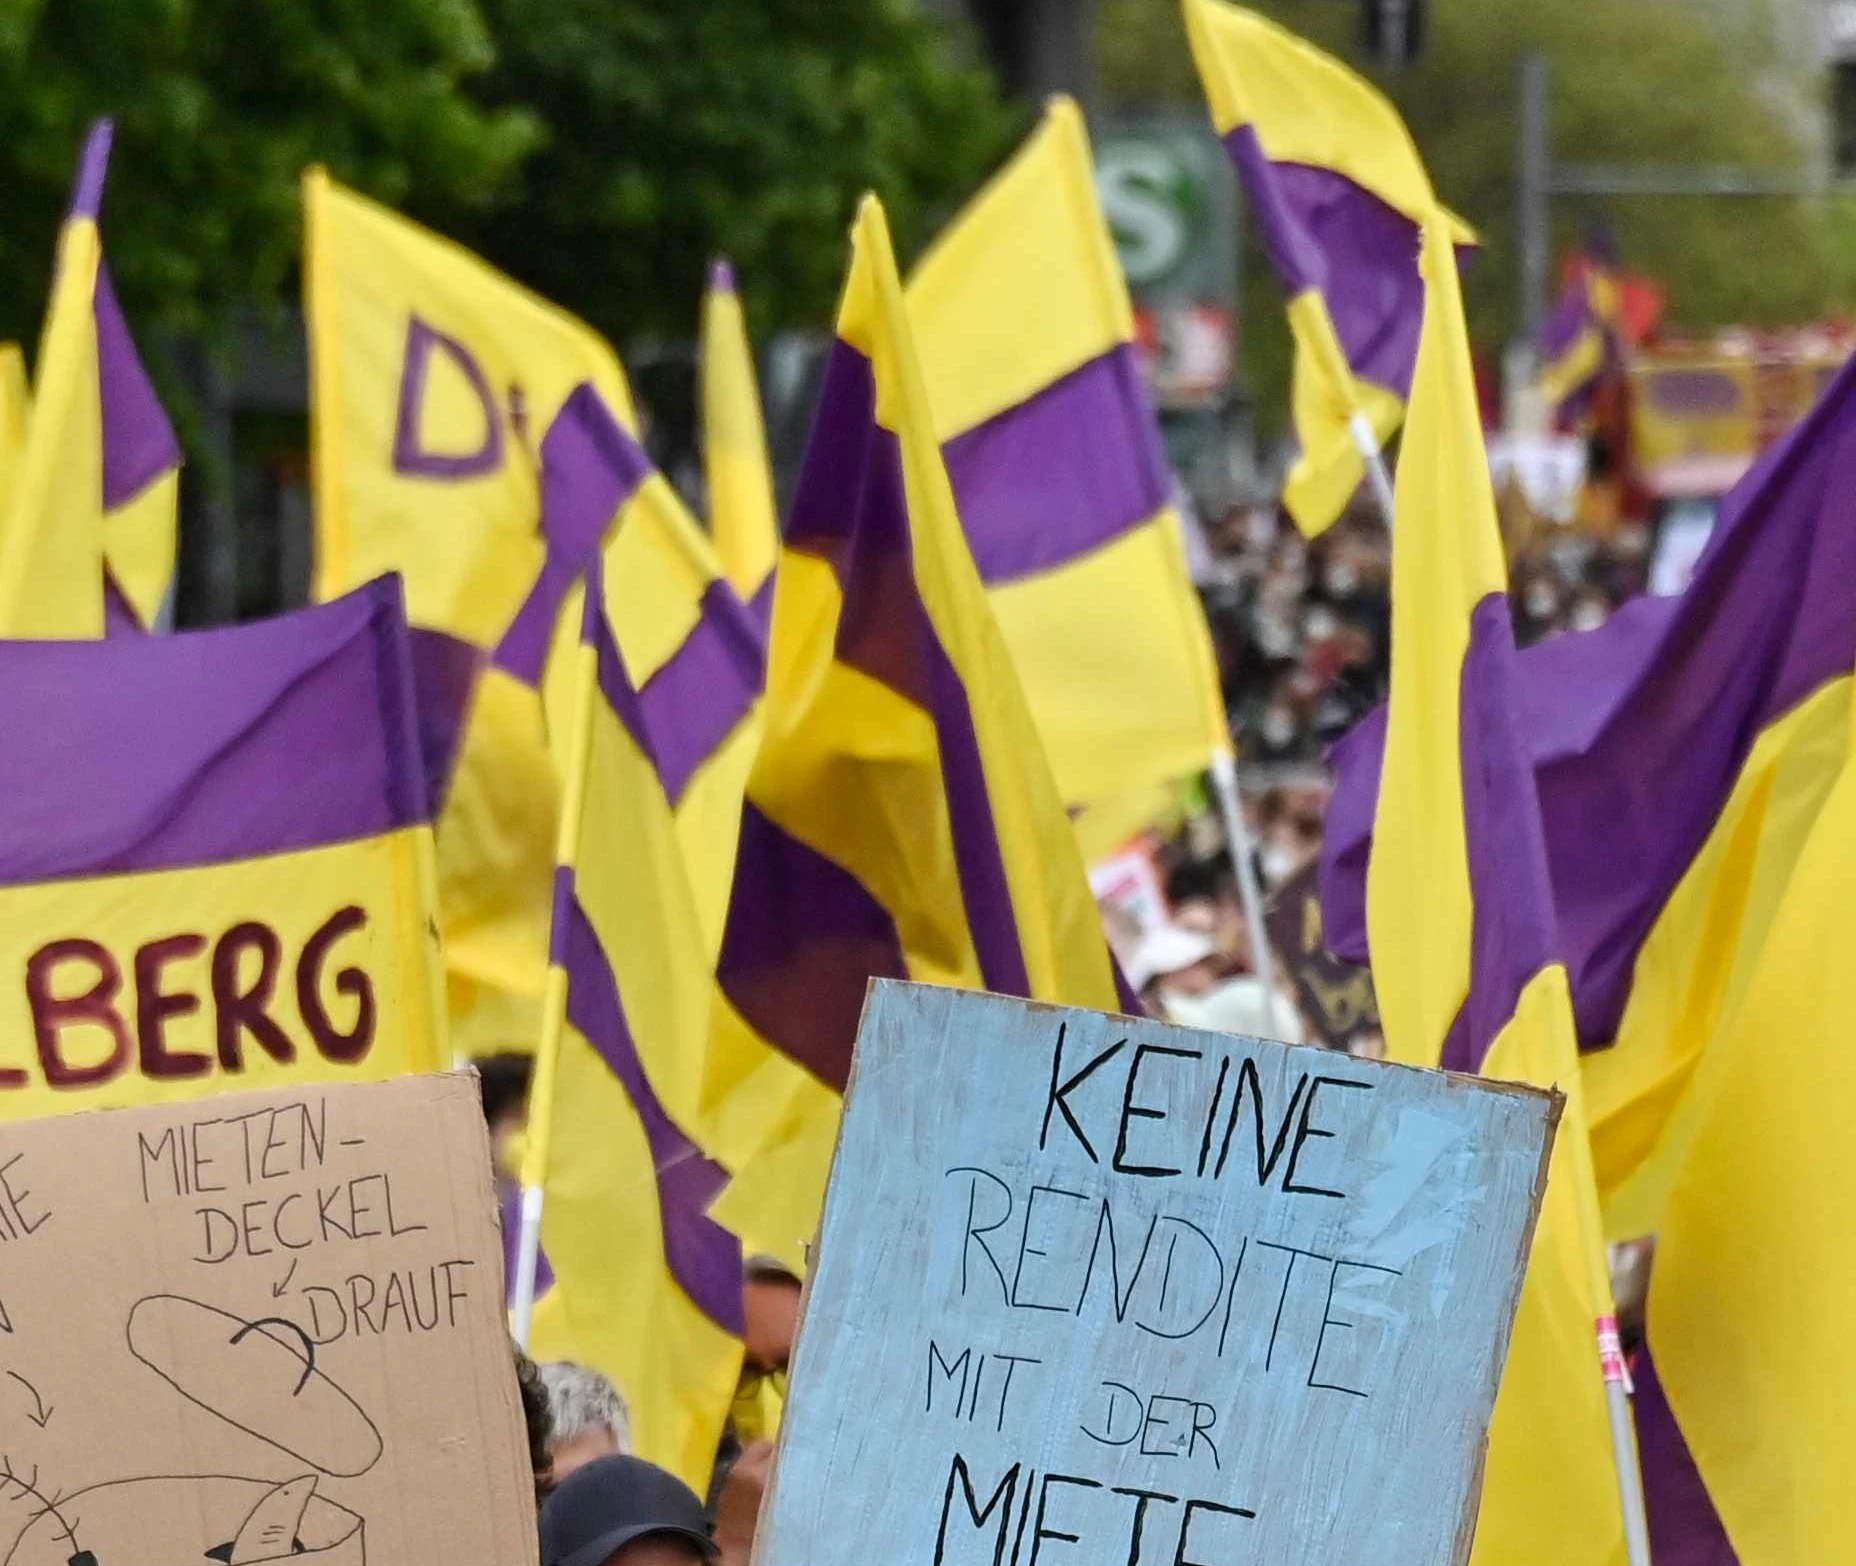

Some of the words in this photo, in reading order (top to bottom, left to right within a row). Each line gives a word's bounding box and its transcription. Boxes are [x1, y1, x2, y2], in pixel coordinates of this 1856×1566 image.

[1039, 1022, 1375, 1198] KEINE
[193, 1173, 428, 1264] DECKEL
[945, 1167, 1403, 1398] RENDITE
[301, 1260, 475, 1346] DRAUF
[926, 1340, 1042, 1432] MIT
[1080, 1381, 1221, 1471] DER
